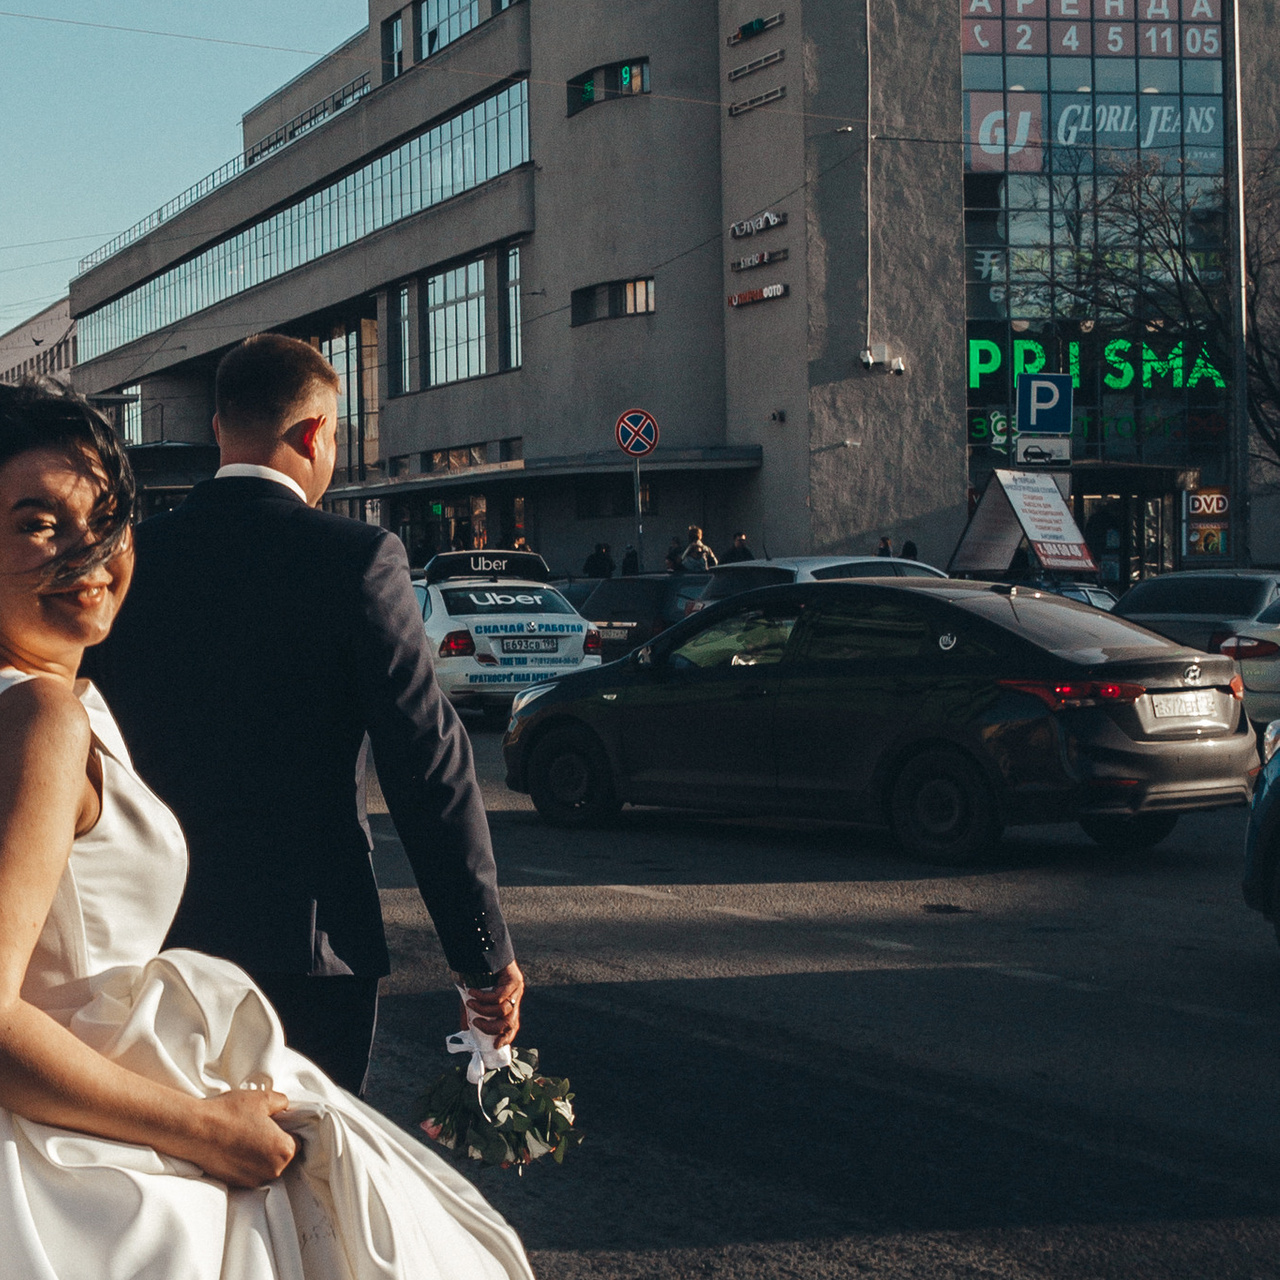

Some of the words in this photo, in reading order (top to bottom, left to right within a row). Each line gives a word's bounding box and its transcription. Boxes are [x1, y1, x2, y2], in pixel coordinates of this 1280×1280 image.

[1140, 105, 1217, 148] JEANS
[969, 338, 1226, 389] PRISMA
[1190, 495, 1228, 513] DVD
[471, 557, 508, 570] Uber
[469, 593, 543, 605] Uber
[474, 623, 525, 635] СКАЧАЙ
[538, 624, 583, 633] РАБОТАЙ
